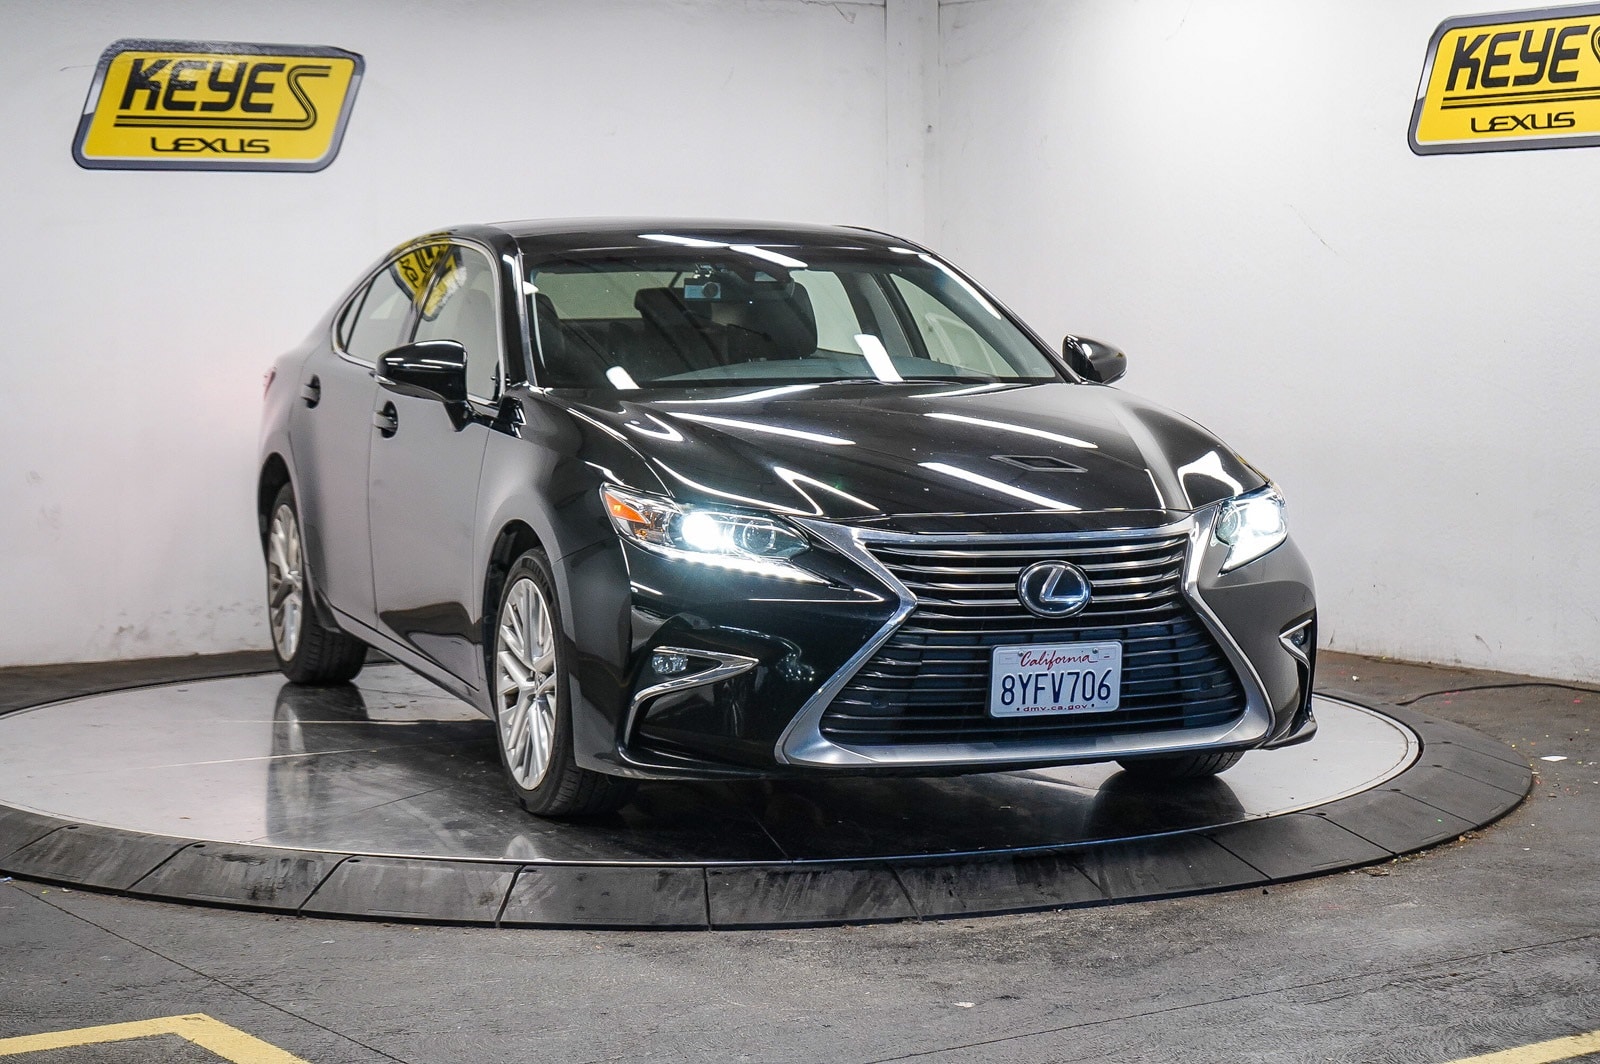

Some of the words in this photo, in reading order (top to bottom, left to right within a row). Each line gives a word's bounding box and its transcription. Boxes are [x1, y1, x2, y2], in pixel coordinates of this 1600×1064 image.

[115, 57, 332, 131] KEYES
[1470, 111, 1576, 133] LEXUS
[151, 136, 270, 154] LEXUS
[1020, 650, 1098, 671] California
[1001, 669, 1113, 706] 8YFV706
[1023, 703, 1088, 712] dmv.ca.gov
